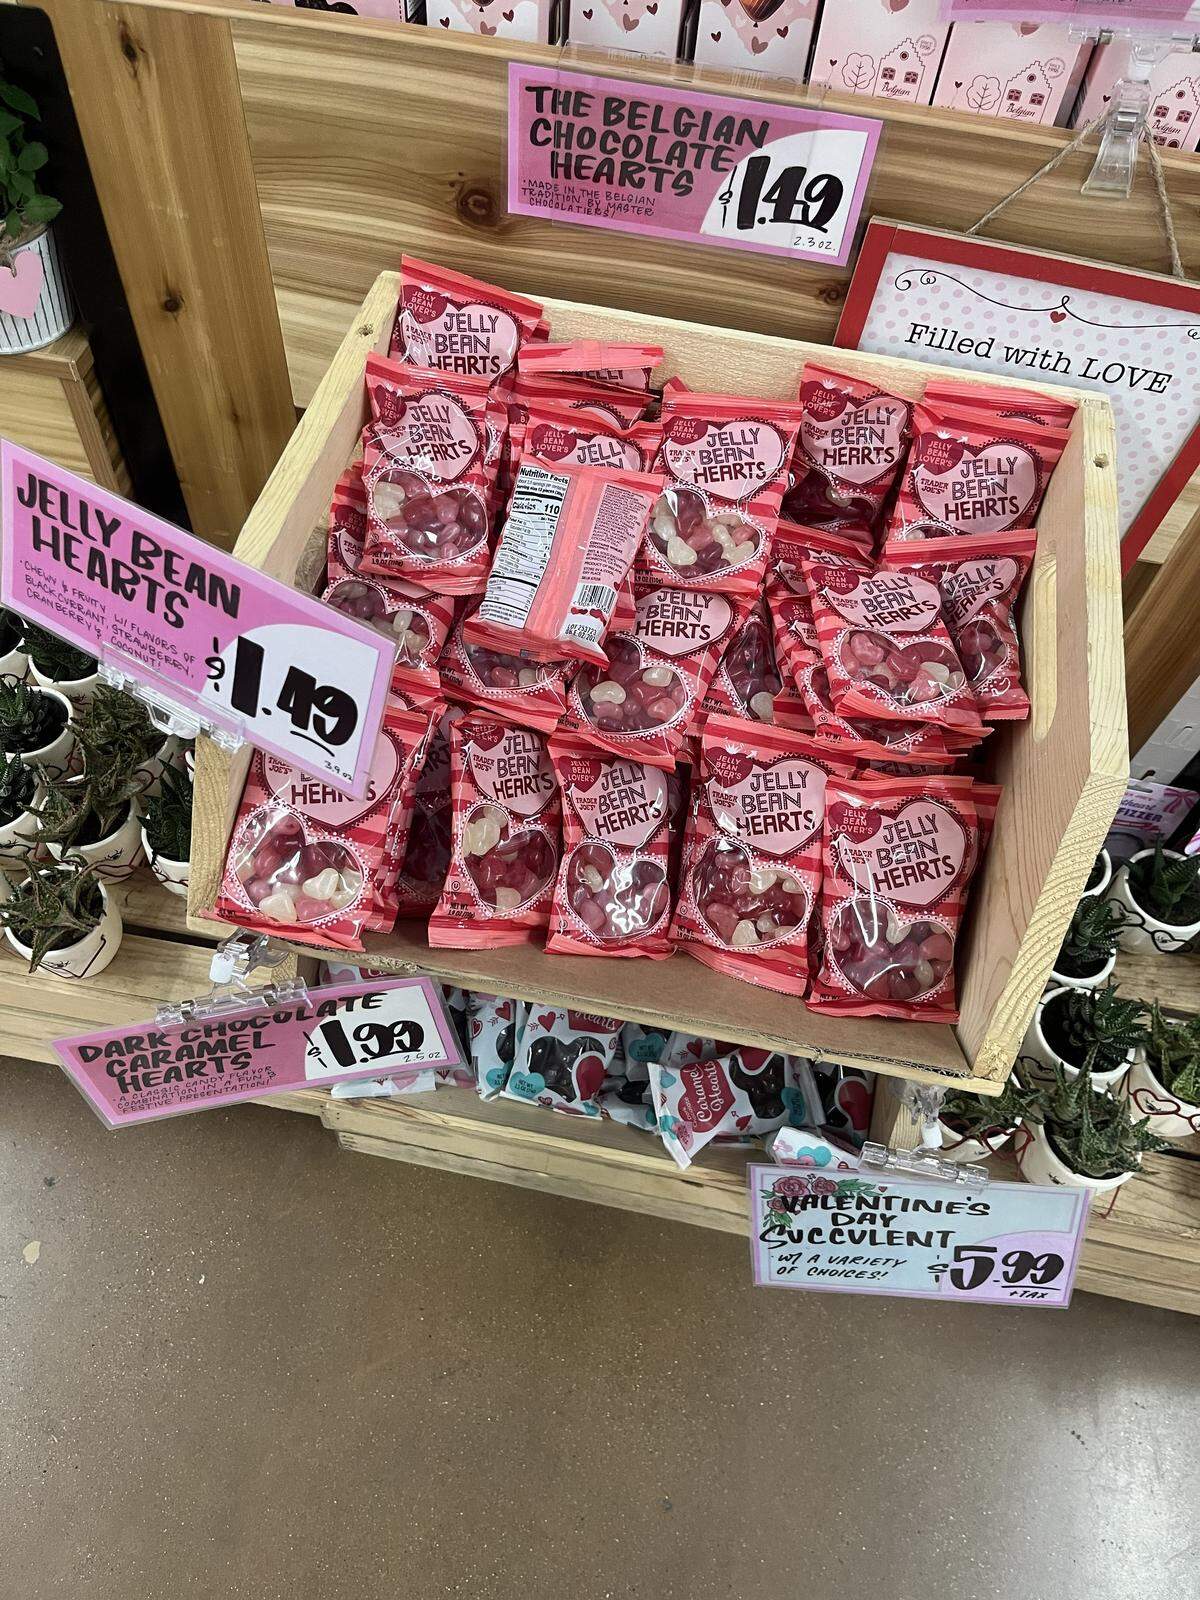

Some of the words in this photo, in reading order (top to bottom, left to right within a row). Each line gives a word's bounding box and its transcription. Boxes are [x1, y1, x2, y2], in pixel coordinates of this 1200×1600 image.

[881, 83, 911, 97] Belgian
[525, 86, 596, 117] THE
[603, 97, 769, 149] BELGIAN
[1006, 104, 1036, 118] Belgian
[1151, 121, 1182, 135] Belgian
[530, 118, 735, 171] CHOCOLATE
[551, 151, 694, 197] HEARTS
[521, 188, 581, 203] TRADITION
[587, 199, 600, 210] BY
[606, 203, 654, 216] MASTER
[564, 185, 575, 194] IN
[580, 189, 600, 198] THE
[605, 192, 655, 206] BELGIAN
[718, 156, 844, 234] $1.49
[411, 297, 433, 309] BEAN
[412, 291, 436, 303] JELLY
[444, 312, 500, 333] JELLY
[434, 334, 490, 354] BEAN
[904, 322, 996, 359] Filled
[1003, 345, 1073, 375] with
[1078, 357, 1173, 394] LOVE
[814, 389, 836, 400] JELLY
[409, 405, 451, 424] JELLY
[803, 401, 836, 417] LOVER'S
[841, 407, 897, 426] JELLY
[408, 423, 454, 443] BEAN
[673, 425, 694, 433] BEAN
[674, 419, 697, 427] JELLY
[543, 437, 565, 445] BEAN
[544, 431, 566, 441] JELLY
[707, 427, 760, 447] JELLY
[831, 426, 885, 446] BEAN
[928, 440, 952, 451] JELLY
[536, 443, 569, 453] LOVER'S
[577, 440, 626, 464] JELLY
[699, 447, 755, 465] BEAN
[823, 446, 895, 466] HEARTS
[927, 447, 949, 459] BEAN
[919, 453, 953, 468] LOVER'S
[960, 456, 1018, 479] JELLY
[520, 468, 549, 479] Nutrition
[693, 461, 766, 484] HEARTS
[920, 477, 949, 490] TRADER
[952, 478, 1009, 501] BEAN
[545, 504, 560, 514] 110
[945, 496, 1019, 522] HEARTS
[17, 473, 121, 547] JELLY
[131, 530, 241, 619] BEAN
[32, 516, 189, 629] HEARTS
[944, 565, 996, 596] JELLY
[862, 576, 912, 595] JELLY
[26, 589, 92, 630] CRANBERRY
[657, 590, 714, 609] JELLY
[861, 590, 917, 613] BEAN
[646, 603, 702, 622] BEAN
[863, 600, 937, 627] HEARTS
[73, 588, 106, 613] FRUITY
[131, 623, 178, 655] FLAVORS
[184, 652, 196, 664] OF
[635, 619, 711, 641] HEARTS
[112, 624, 195, 678] STRAWBERRY,
[497, 755, 540, 778] BEAN
[715, 761, 738, 771] BEAN
[717, 755, 741, 765] JELLY
[493, 772, 553, 801] HEARTS
[568, 774, 595, 782] LOVER'S
[601, 764, 646, 791] JELLY
[750, 770, 809, 792] JELLY
[599, 785, 647, 815] BEAN
[712, 791, 738, 802] TRADER
[742, 791, 801, 815] BEAN
[595, 800, 662, 836] HEARTS
[736, 809, 815, 836] HEARTS
[843, 808, 867, 817] JELLY
[843, 818, 867, 826] BEAN
[836, 824, 873, 835] LOVER'S
[883, 813, 939, 845] JELLY
[876, 837, 939, 869] BEAN
[873, 855, 956, 892] HEARTS
[78, 1032, 172, 1063] DARK
[181, 992, 389, 1043] CHOCOLATE
[106, 1031, 276, 1078] CARAMEL
[116, 1051, 252, 1094] HEARTS
[118, 1088, 198, 1110] COMBINATION
[202, 1082, 213, 1091] IN
[224, 1079, 232, 1087] A
[238, 1074, 263, 1085] FUN
[119, 1096, 127, 1104] A
[132, 1086, 180, 1101] CLASSIC
[185, 1075, 224, 1088] CANDY
[230, 1066, 272, 1079] FLAVOR
[683, 1063, 713, 1122] Caramel
[705, 1061, 725, 1112] Hearts
[122, 1100, 173, 1114] FESTIVE
[781, 1194, 991, 1217] VALENTINE'S
[831, 1212, 898, 1227] DAY
[759, 1224, 956, 1249] SUCCULENT
[807, 1254, 822, 1264] A
[828, 1254, 908, 1267] VARIETY
[927, 1244, 1065, 1291] $5.99
[776, 1266, 797, 1275] OF
[807, 1266, 889, 1280] CHOICES!
